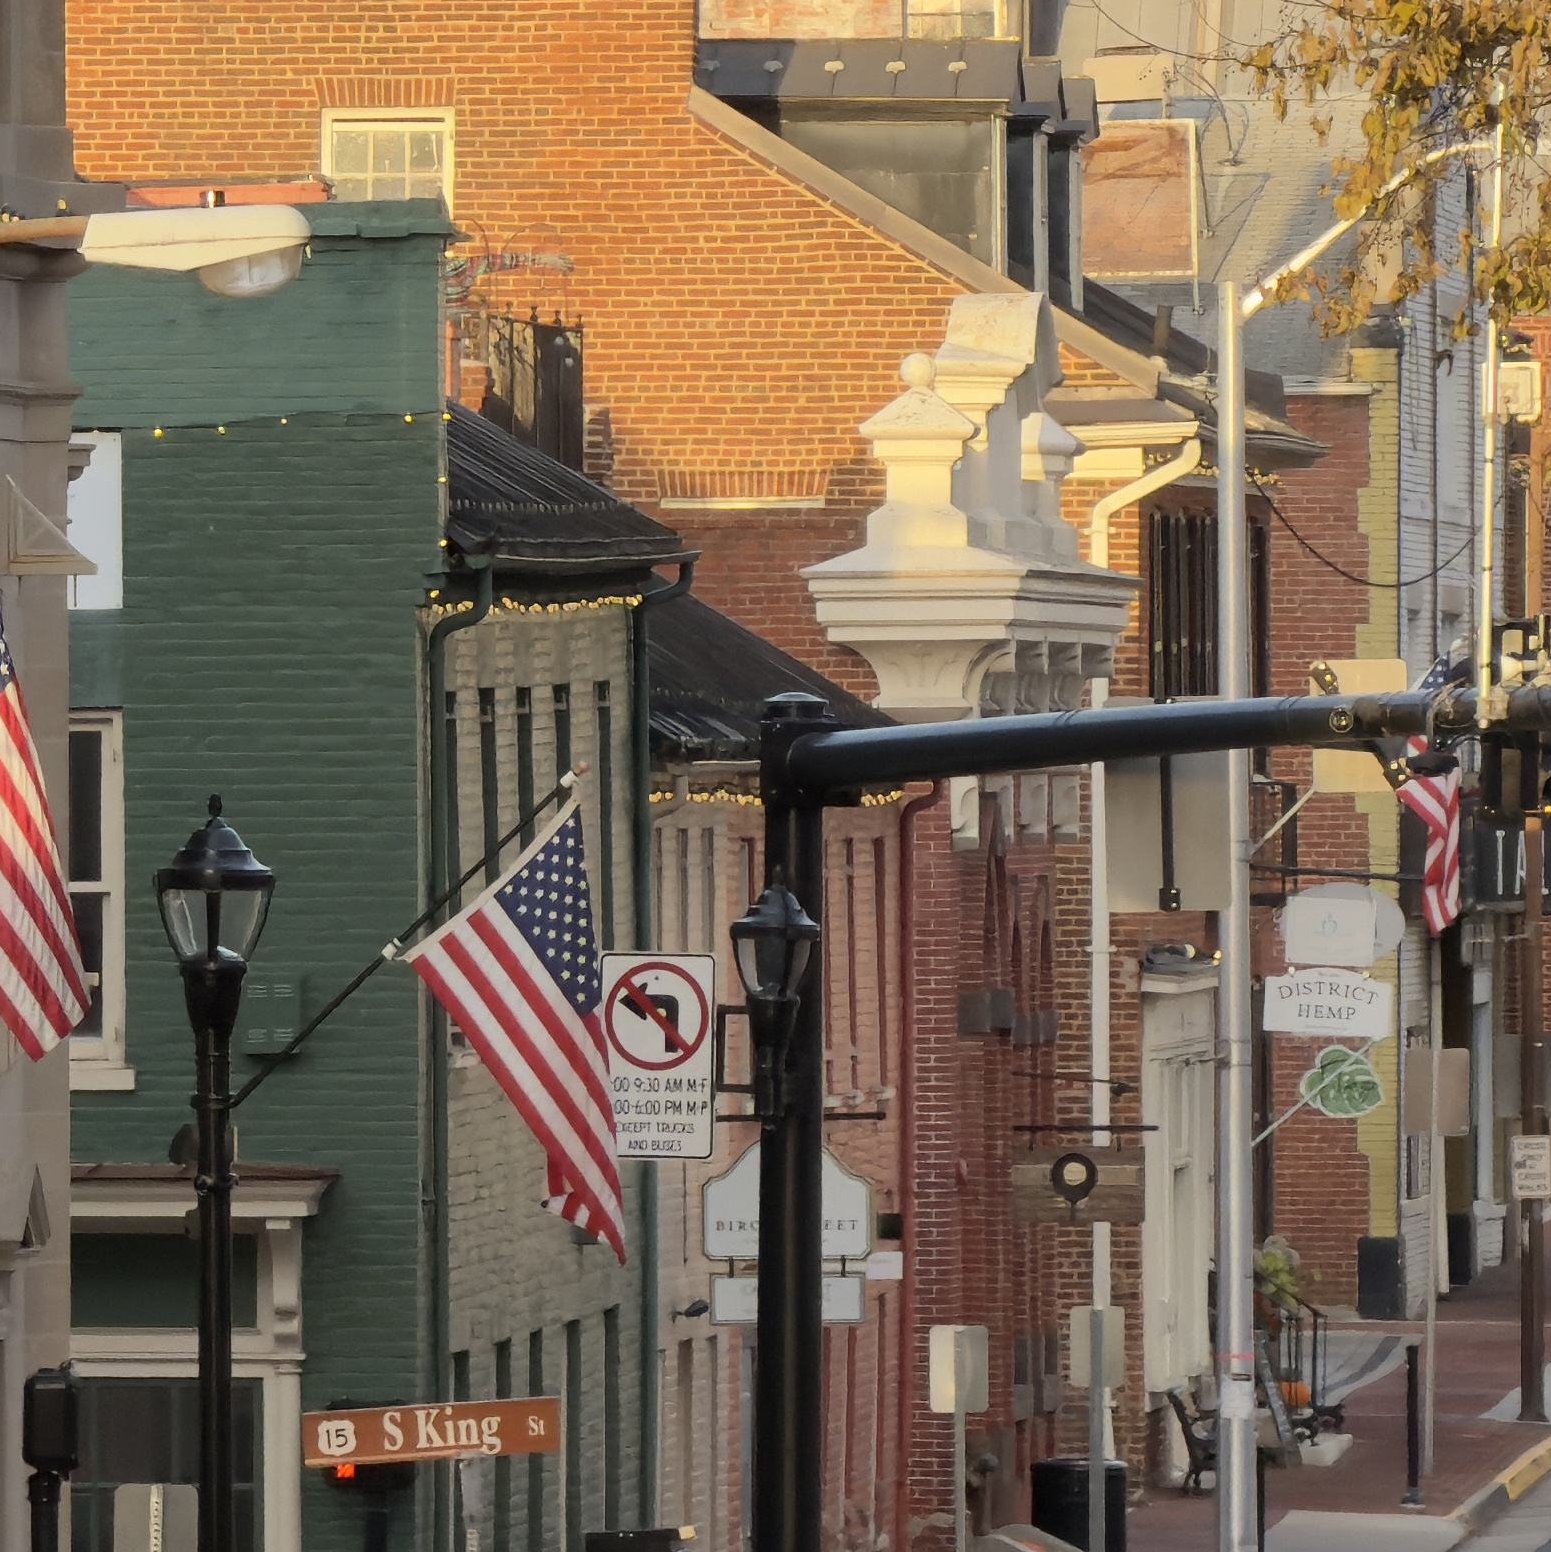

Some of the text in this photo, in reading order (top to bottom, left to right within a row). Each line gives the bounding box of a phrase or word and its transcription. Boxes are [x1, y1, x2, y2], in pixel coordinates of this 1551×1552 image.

[1279, 981, 1379, 1005] DISTRICT
[1297, 1003, 1356, 1020] HEMP
[664, 1078, 682, 1092] AM
[664, 1100, 682, 1115] PM
[324, 1406, 546, 1455] 15 S King St
